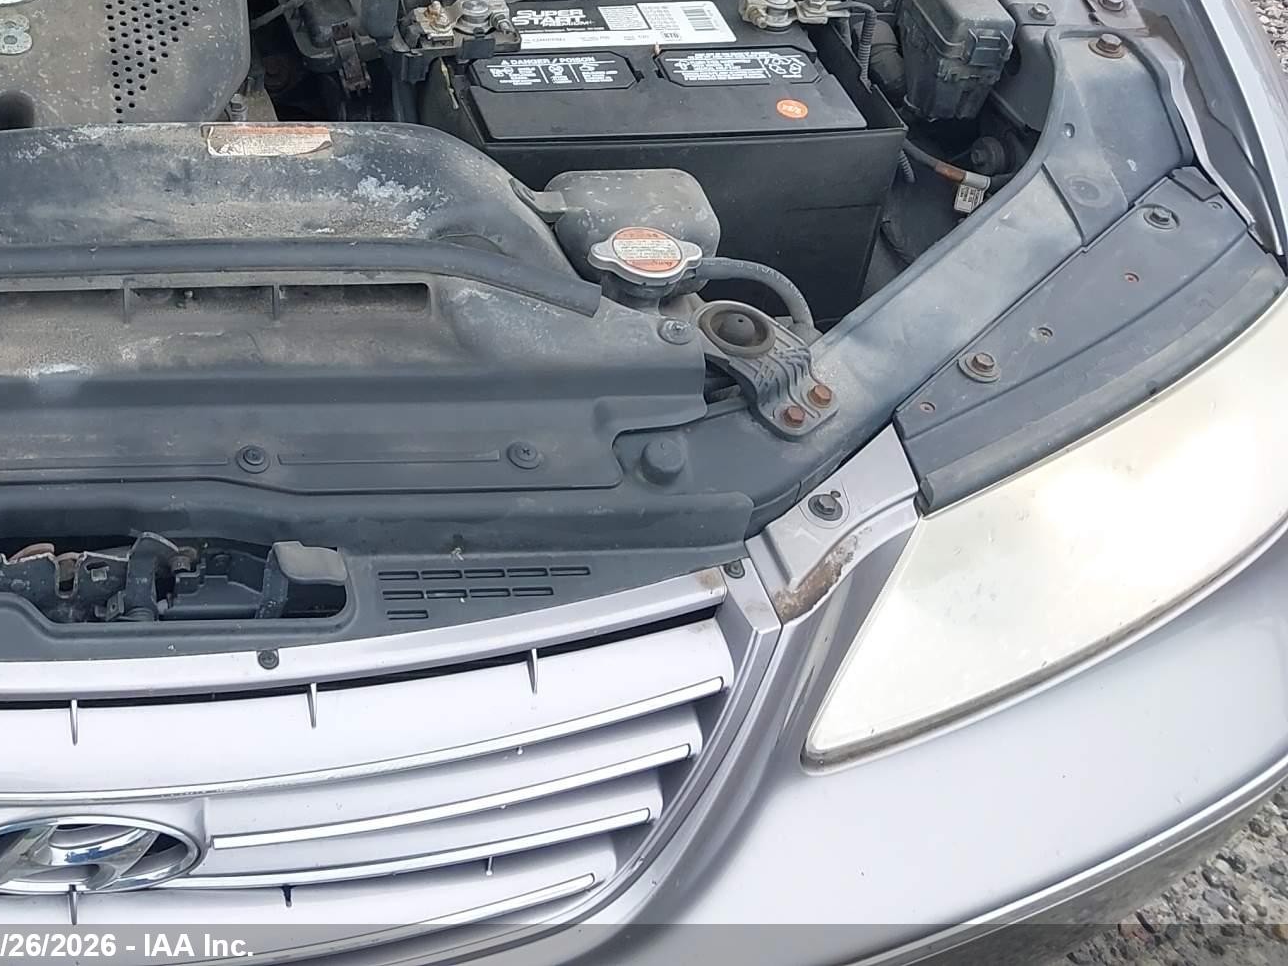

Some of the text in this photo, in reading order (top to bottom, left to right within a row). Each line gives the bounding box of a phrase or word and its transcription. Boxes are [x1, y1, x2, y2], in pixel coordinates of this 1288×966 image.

[516, 9, 586, 18] SUPER
[512, 16, 582, 26] START
[511, 57, 550, 66] DANGER
[559, 56, 595, 64] POISON
